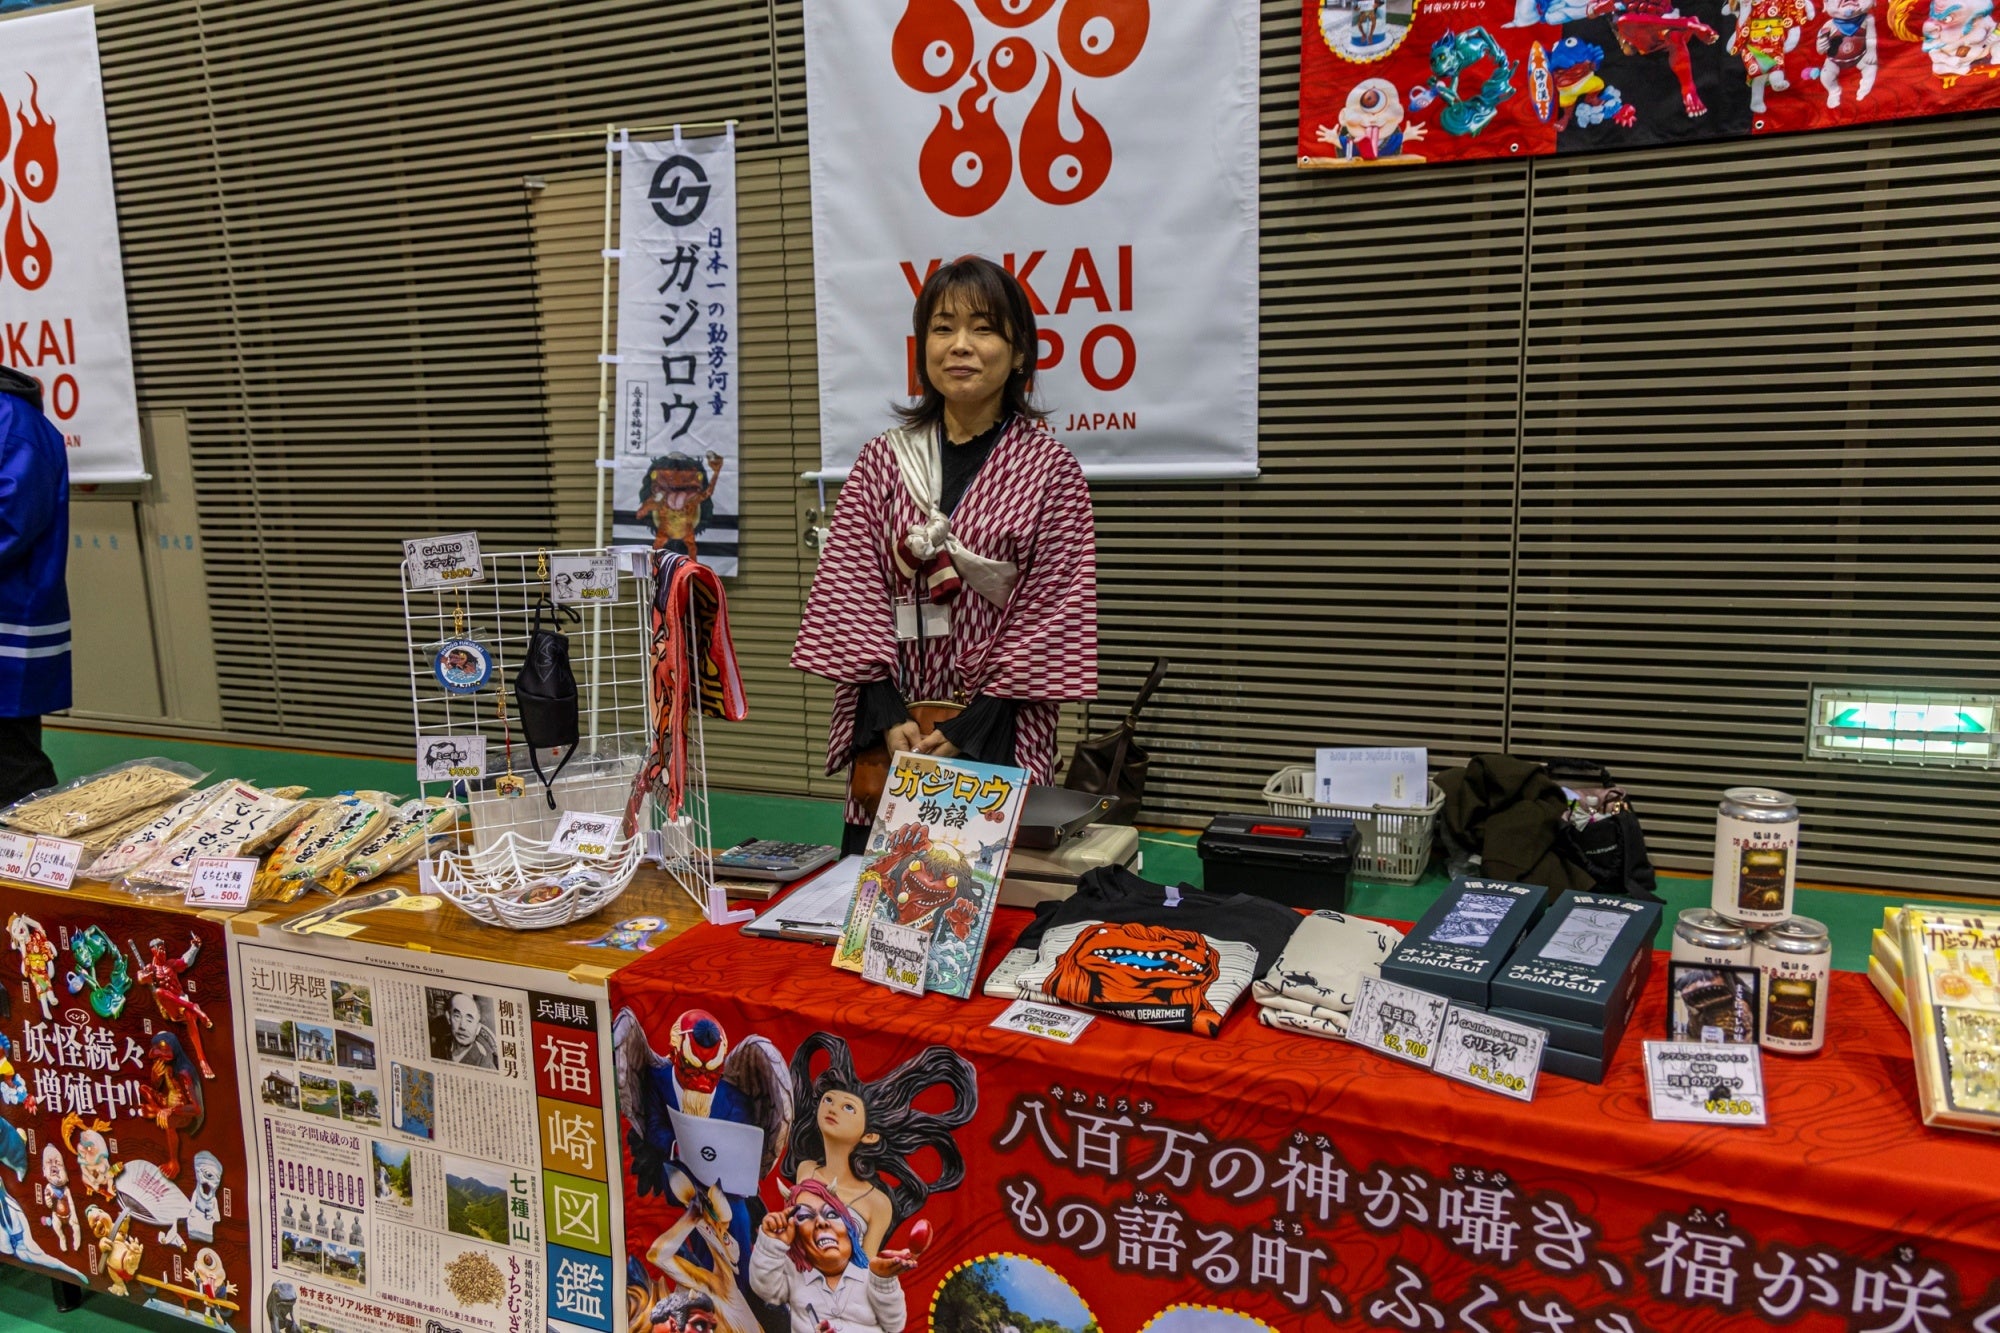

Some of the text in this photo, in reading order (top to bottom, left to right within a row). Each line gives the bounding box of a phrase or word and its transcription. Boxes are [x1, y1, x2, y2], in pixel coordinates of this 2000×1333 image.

[900, 245, 1133, 315] YKAI
[706, 226, 728, 416] 日本一の勤労河童
[0, 318, 75, 368] KAI
[657, 243, 701, 440] ガジロウ
[1065, 412, 1137, 431] JAPAN
[423, 543, 462, 556] GAJIRO
[423, 556, 466, 570] ステッカー
[581, 588, 610, 598] ¥500
[889, 766, 1013, 815] ガジロウ
[917, 799, 969, 831] 物語
[6, 863, 20, 874] 300
[50, 871, 65, 881] 700
[202, 870, 243, 882] もちむぎ麺
[220, 891, 239, 900] 500
[1397, 955, 1482, 974] ORINUGUI
[1400, 947, 1490, 967] オリヌグイ
[251, 966, 328, 1001] 辻川界隈
[1508, 972, 1599, 994] ORINUGUI
[1511, 965, 1607, 987] オリヌグイ
[537, 999, 590, 1026] 兵庫県
[1118, 1010, 1137, 1020] PARK
[1137, 1008, 1186, 1020] DEPARTMENT
[1379, 1003, 1417, 1025] 風呂敷
[1459, 1018, 1493, 1035] GAJIRO
[22, 1019, 145, 1071] 妖怪続々
[499, 999, 519, 1079] 柳田國男
[1463, 1035, 1518, 1061] オリヌグイ
[1468, 1063, 1527, 1092] ¥3,500
[1667, 1075, 1744, 1089] 河童のガジロウ
[1050, 1085, 1154, 1116] やおよろず
[1704, 1100, 1752, 1115] ¥250
[297, 1124, 361, 1151] 学問成就の道
[1294, 1131, 1332, 1149] かみ
[1454, 1166, 1508, 1188] ささや
[510, 1172, 531, 1243] 七種山
[1135, 1190, 1169, 1206] かた
[1272, 1218, 1305, 1237] まち
[1688, 1209, 1727, 1228] ふく
